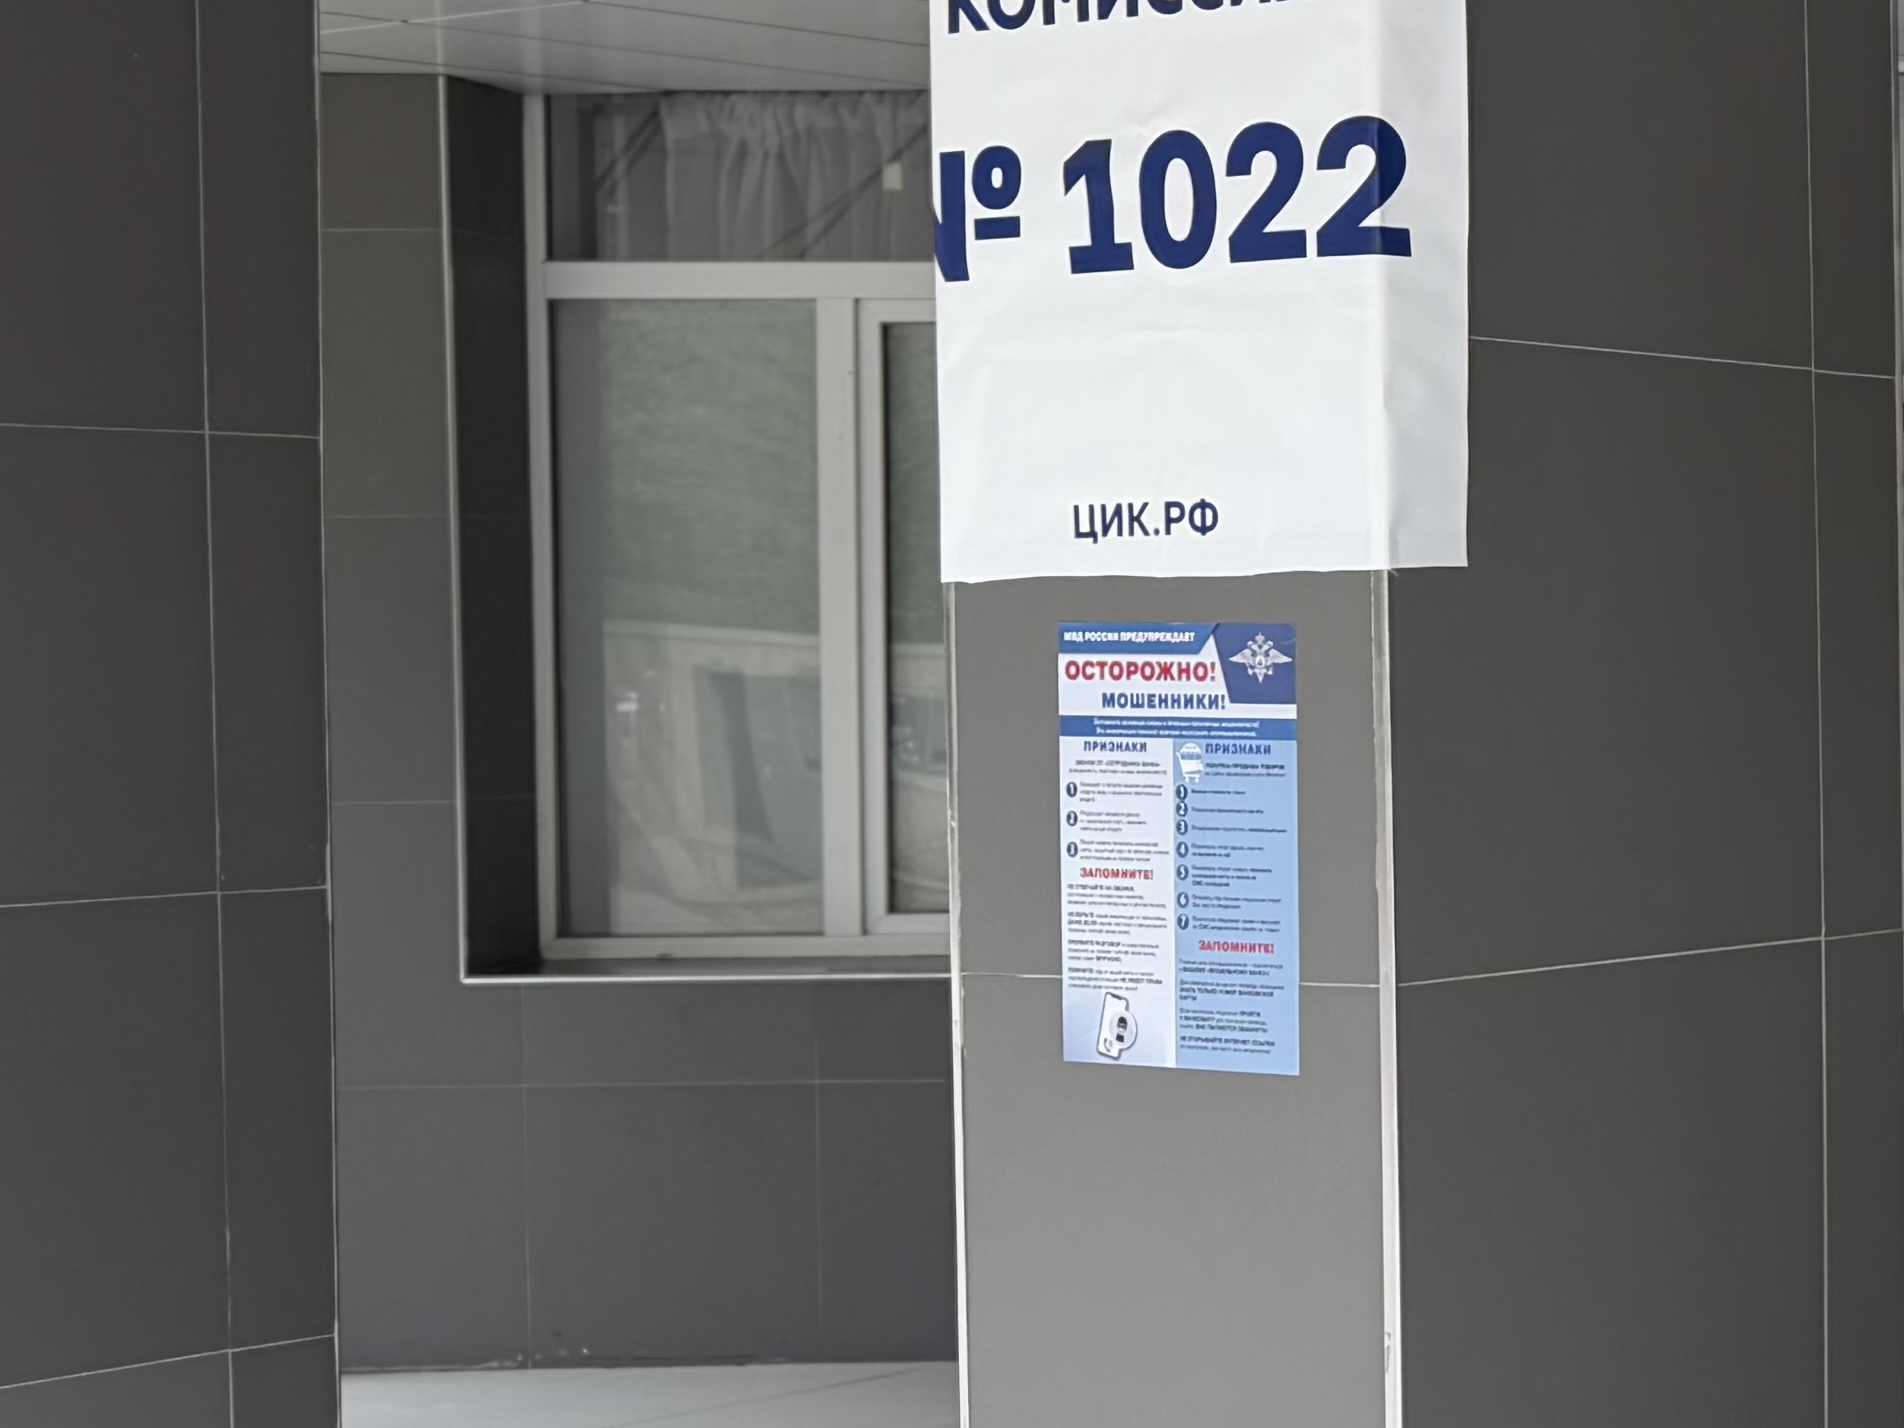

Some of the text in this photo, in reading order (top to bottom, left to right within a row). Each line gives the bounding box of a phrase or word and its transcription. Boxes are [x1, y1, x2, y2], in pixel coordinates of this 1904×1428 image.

[1063, 115, 1412, 275] 1022
[1073, 498, 1219, 544] ЦИК.РФ
[1065, 660, 1216, 682] ОСТОРОЖНО!
[1102, 692, 1226, 710] МОШЕННИКИ!
[1083, 740, 1147, 753] ПРИЗНАКИ
[1204, 742, 1271, 755] ПРИЗНАКИ
[1080, 867, 1153, 880] ЗАПОМНИТЕ!
